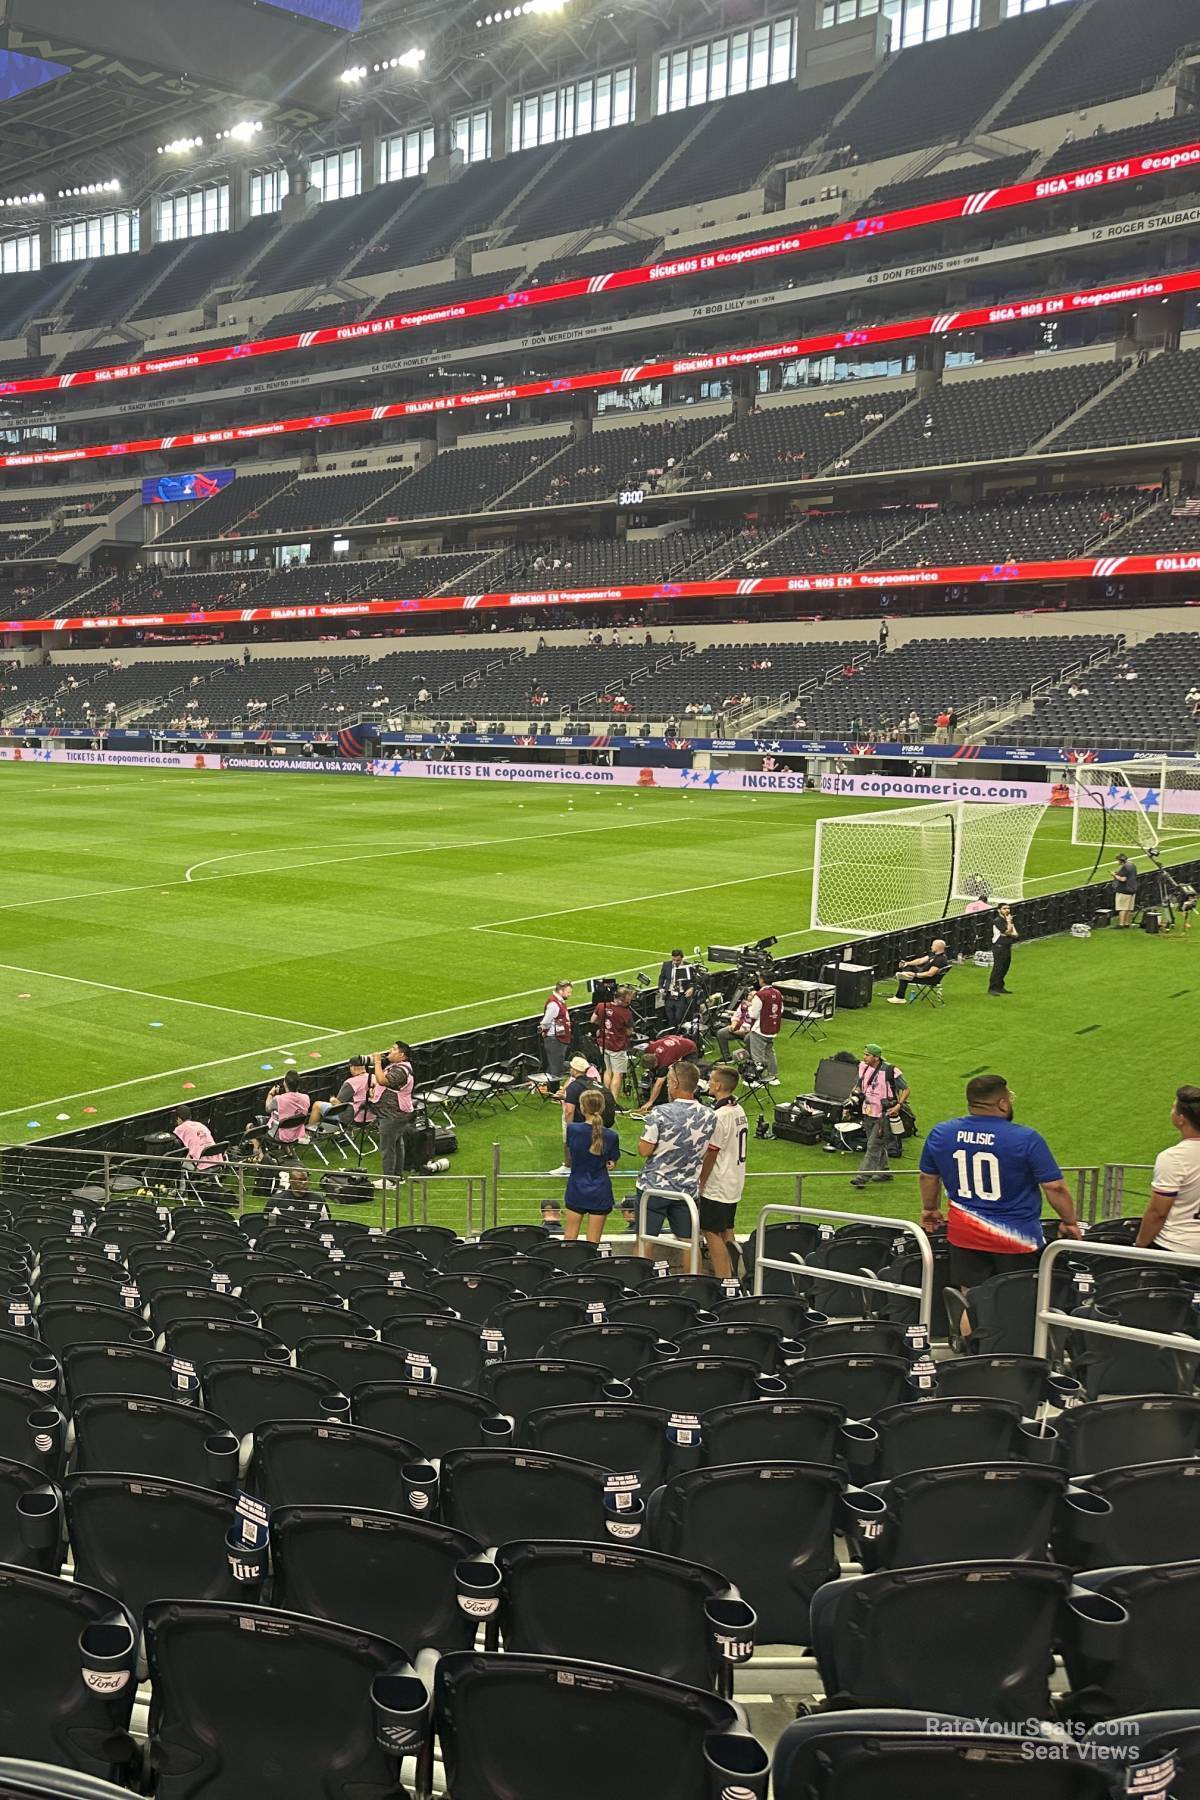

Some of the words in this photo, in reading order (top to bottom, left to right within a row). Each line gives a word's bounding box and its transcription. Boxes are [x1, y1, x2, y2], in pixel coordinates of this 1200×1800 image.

[1035, 170, 1103, 197] SIGA-NOS
[1106, 164, 1130, 181] EM
[1141, 149, 1200, 169] @copaa
[1092, 231, 1102, 239] 12
[1108, 221, 1145, 237] ROGER
[649, 259, 698, 279] SÍGUENOS
[700, 257, 715, 269] EN
[717, 239, 800, 263] @copaamerica
[867, 275, 879, 284] 43
[882, 270, 902, 281] DON
[905, 262, 943, 277] PERKINS
[692, 309, 702, 317] 74
[705, 305, 723, 315] BOB
[725, 300, 745, 311] LILLY
[988, 303, 1043, 321] SIGA-NOS
[1046, 299, 1064, 313] EM
[1072, 282, 1163, 305] @copaamerica
[337, 324, 370, 339] FOLLOW
[371, 322, 382, 333] US
[383, 320, 395, 330] AT
[400, 307, 465, 326] @copaamerica
[531, 336, 546, 345] DON
[548, 330, 584, 342] MEREDITH
[729, 345, 798, 362] @copaamerica
[382, 361, 401, 371] CHUCK
[403, 357, 429, 368] HOWLEY
[405, 402, 434, 413] FOLLOW
[619, 490, 643, 505] 30:00
[1156, 557, 1200, 571] FOLLO
[788, 578, 835, 590] SIGA-NOS
[837, 577, 852, 587] EM
[860, 572, 939, 585] @copaamerica
[66, 752, 96, 762] TICKETS
[97, 753, 106, 762] AT
[107, 754, 181, 766] copaamerica.com
[229, 758, 269, 769] CONMEBOL
[270, 760, 288, 769] COPA
[288, 760, 324, 770] AMERICA
[326, 761, 341, 770] USA
[342, 762, 362, 771] 2024
[425, 764, 471, 777] TICKETS
[476, 766, 491, 777] EN
[495, 767, 614, 782] copaamerica.com
[834, 778, 854, 792] EM
[861, 780, 1028, 799] copaamerica.com
[957, 1130, 996, 1146] PULISIC
[952, 1149, 1002, 1202] 10
[612, 1525, 636, 1535] Ford
[230, 1560, 260, 1581] Lite
[463, 1599, 492, 1614] Ford
[88, 1673, 122, 1691] Ford
